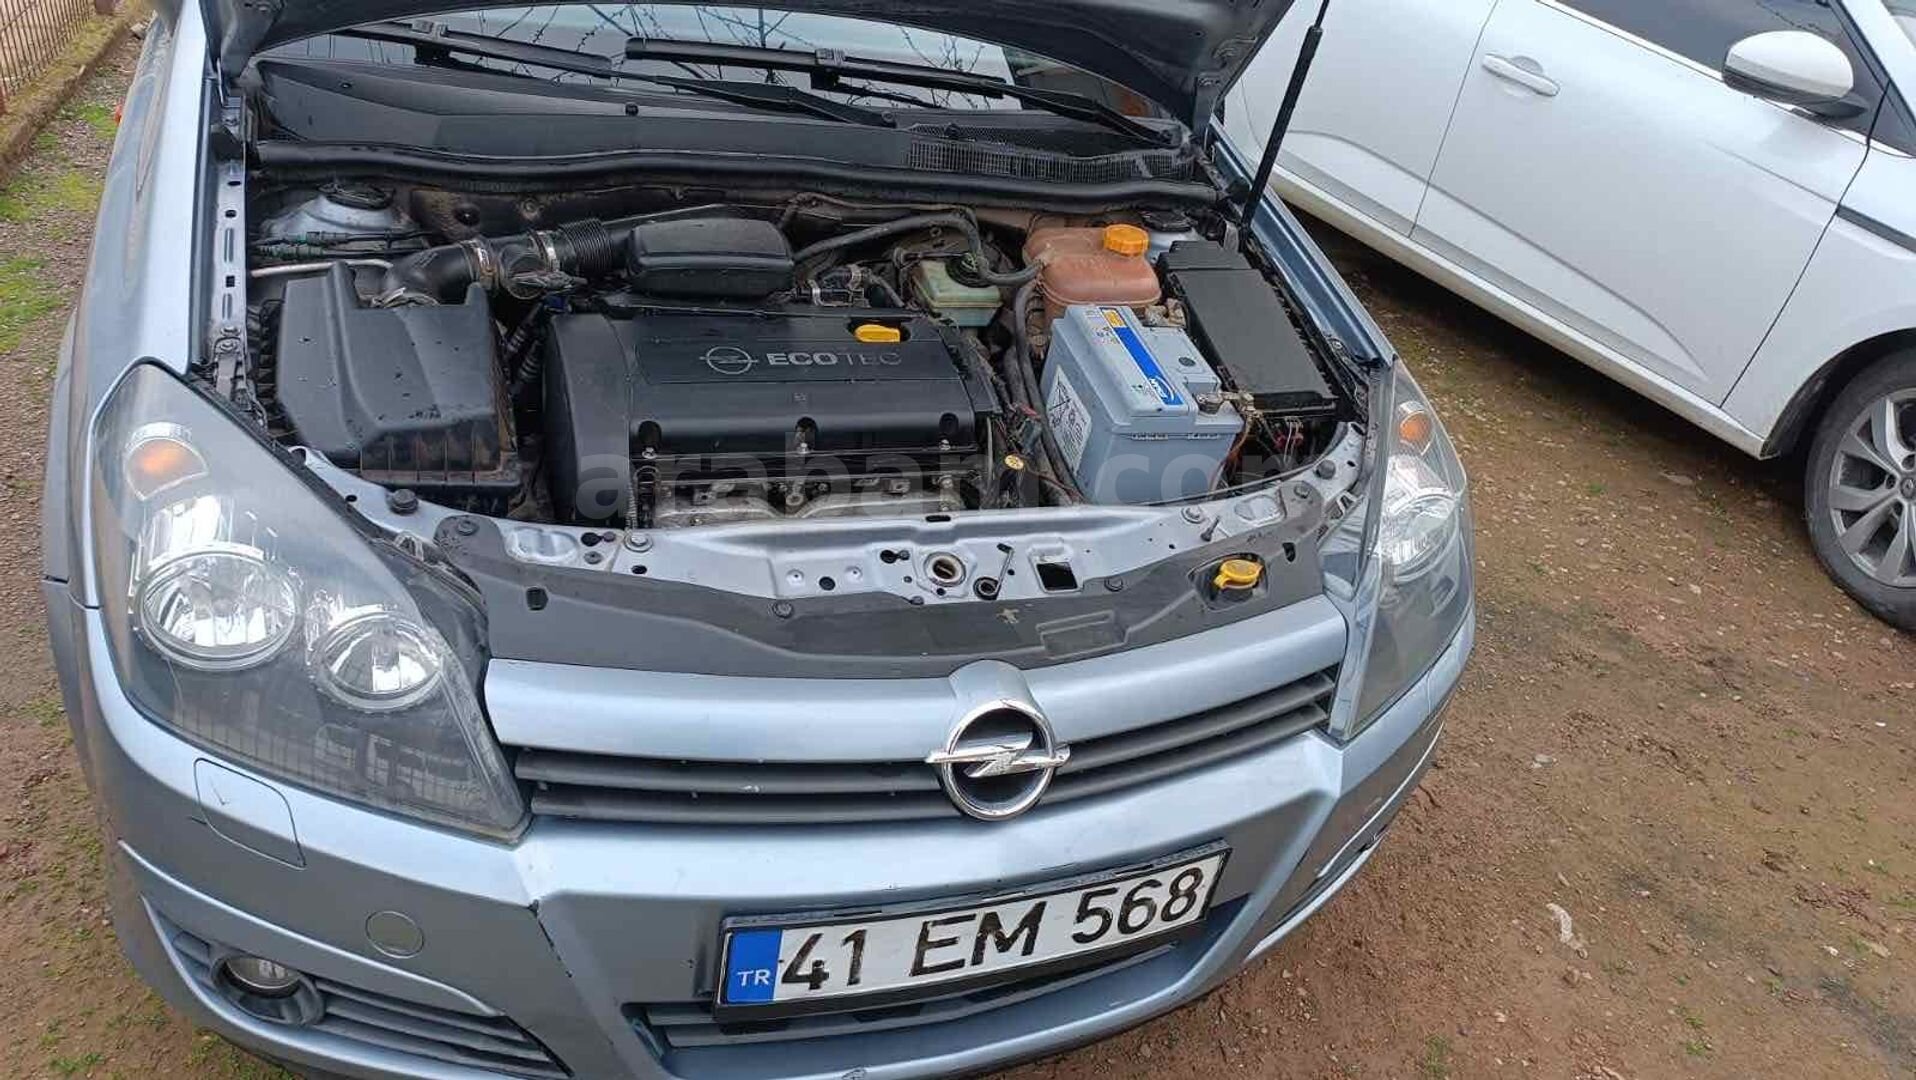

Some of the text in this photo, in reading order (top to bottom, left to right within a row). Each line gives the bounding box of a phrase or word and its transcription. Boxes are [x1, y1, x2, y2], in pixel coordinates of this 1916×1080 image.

[766, 352, 901, 366] ECOTEC
[737, 866, 1205, 991] TR 41 EM 568
